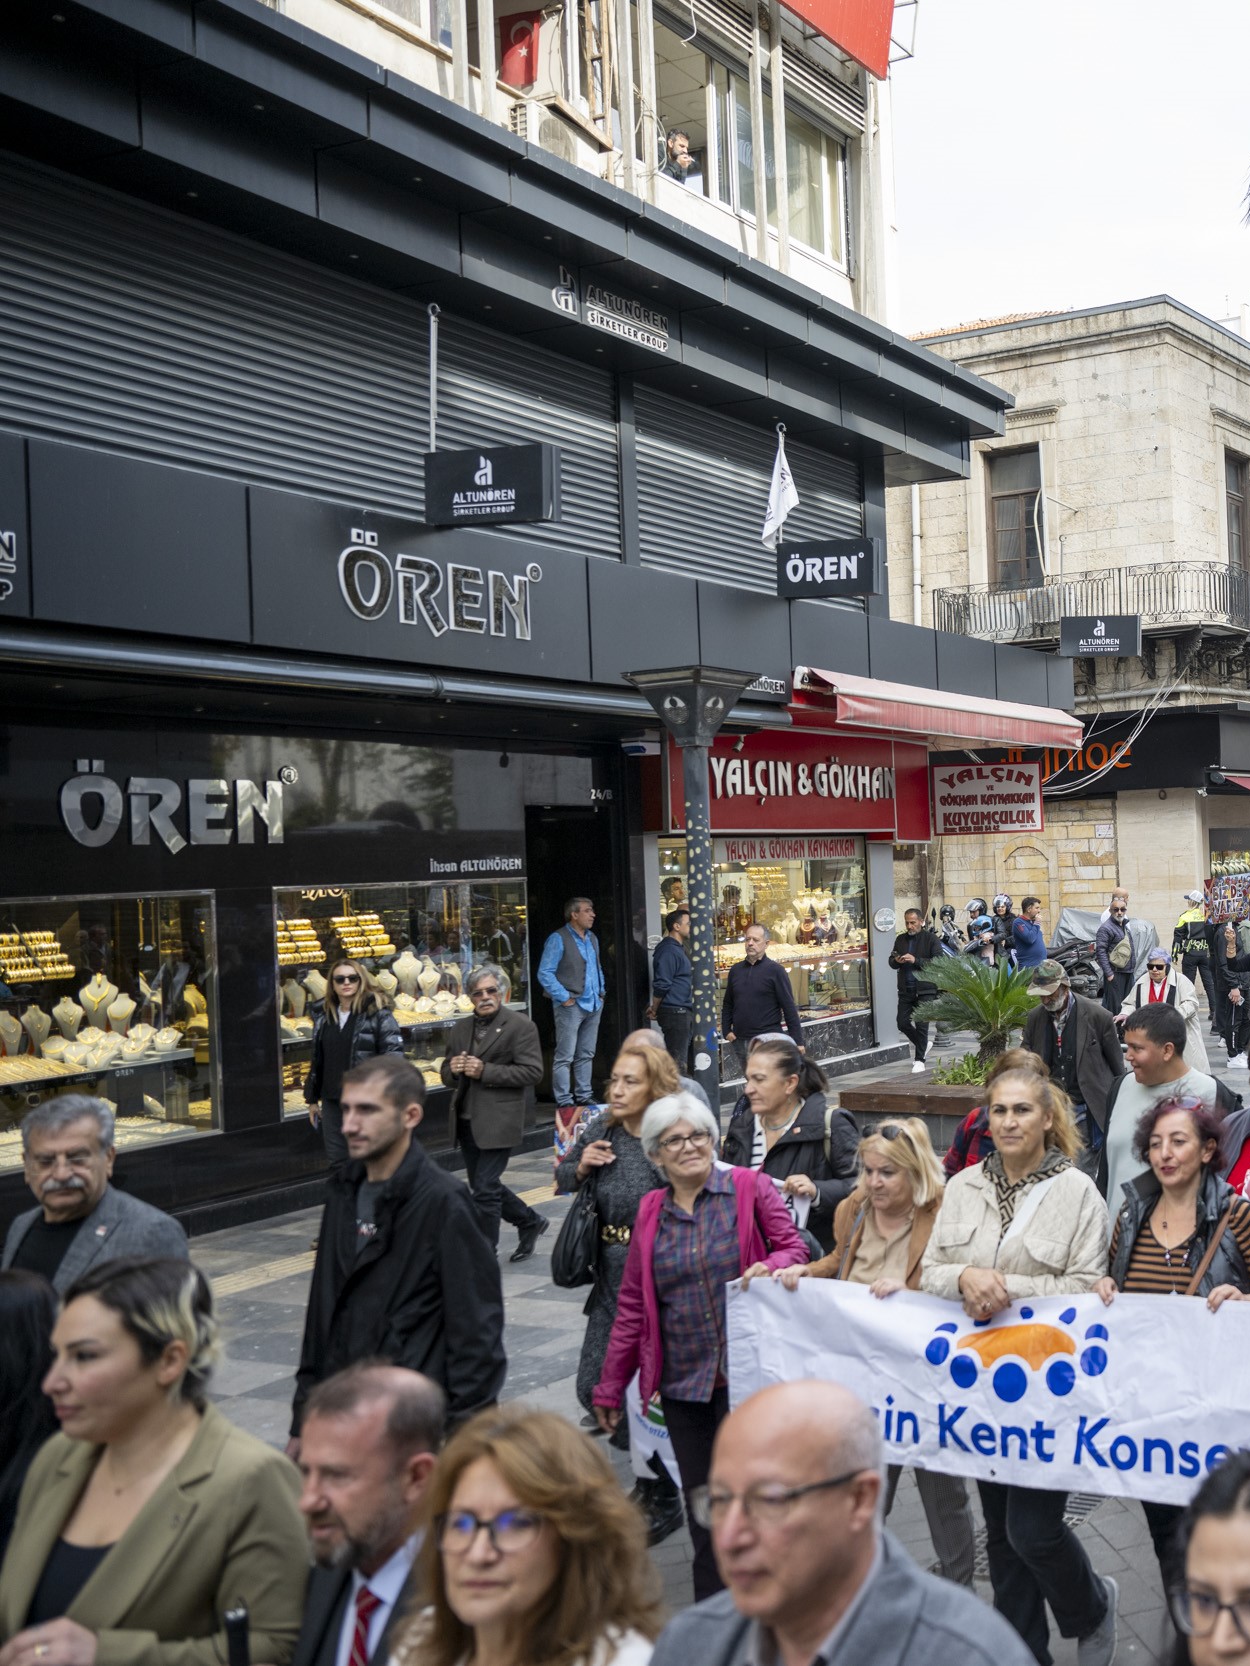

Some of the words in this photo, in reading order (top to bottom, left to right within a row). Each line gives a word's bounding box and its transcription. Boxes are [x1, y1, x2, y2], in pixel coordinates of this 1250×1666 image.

[586, 284, 669, 333] ALTUNÖREN
[640, 333, 669, 352] GROUP
[453, 488, 516, 504] ALTUNÖREN
[492, 505, 516, 514] GROUP
[786, 554, 858, 584] ÖREN
[338, 528, 532, 641] ÖREN
[1079, 637, 1120, 646] ALTUNÖREN
[710, 757, 793, 806] YALÇIN
[797, 763, 814, 796] &
[814, 756, 896, 803] GÖKHAN
[939, 767, 1034, 789] YALÇIN
[590, 788, 613, 800] 24/B
[986, 784, 995, 792] VE
[60, 759, 285, 855] ÖREN
[940, 793, 978, 807] GÖKHAN
[943, 809, 1036, 827] KUYUMCULUK
[725, 839, 757, 862] YALÇIN
[759, 841, 767, 858] &
[769, 838, 805, 860] GÖKHAN
[807, 839, 856, 859] KAYNAKKAN
[429, 857, 458, 873] İhsan
[460, 856, 523, 873] ALTUNÖREN
[1230, 882, 1243, 899] DE
[937, 1403, 1056, 1463] Kent
